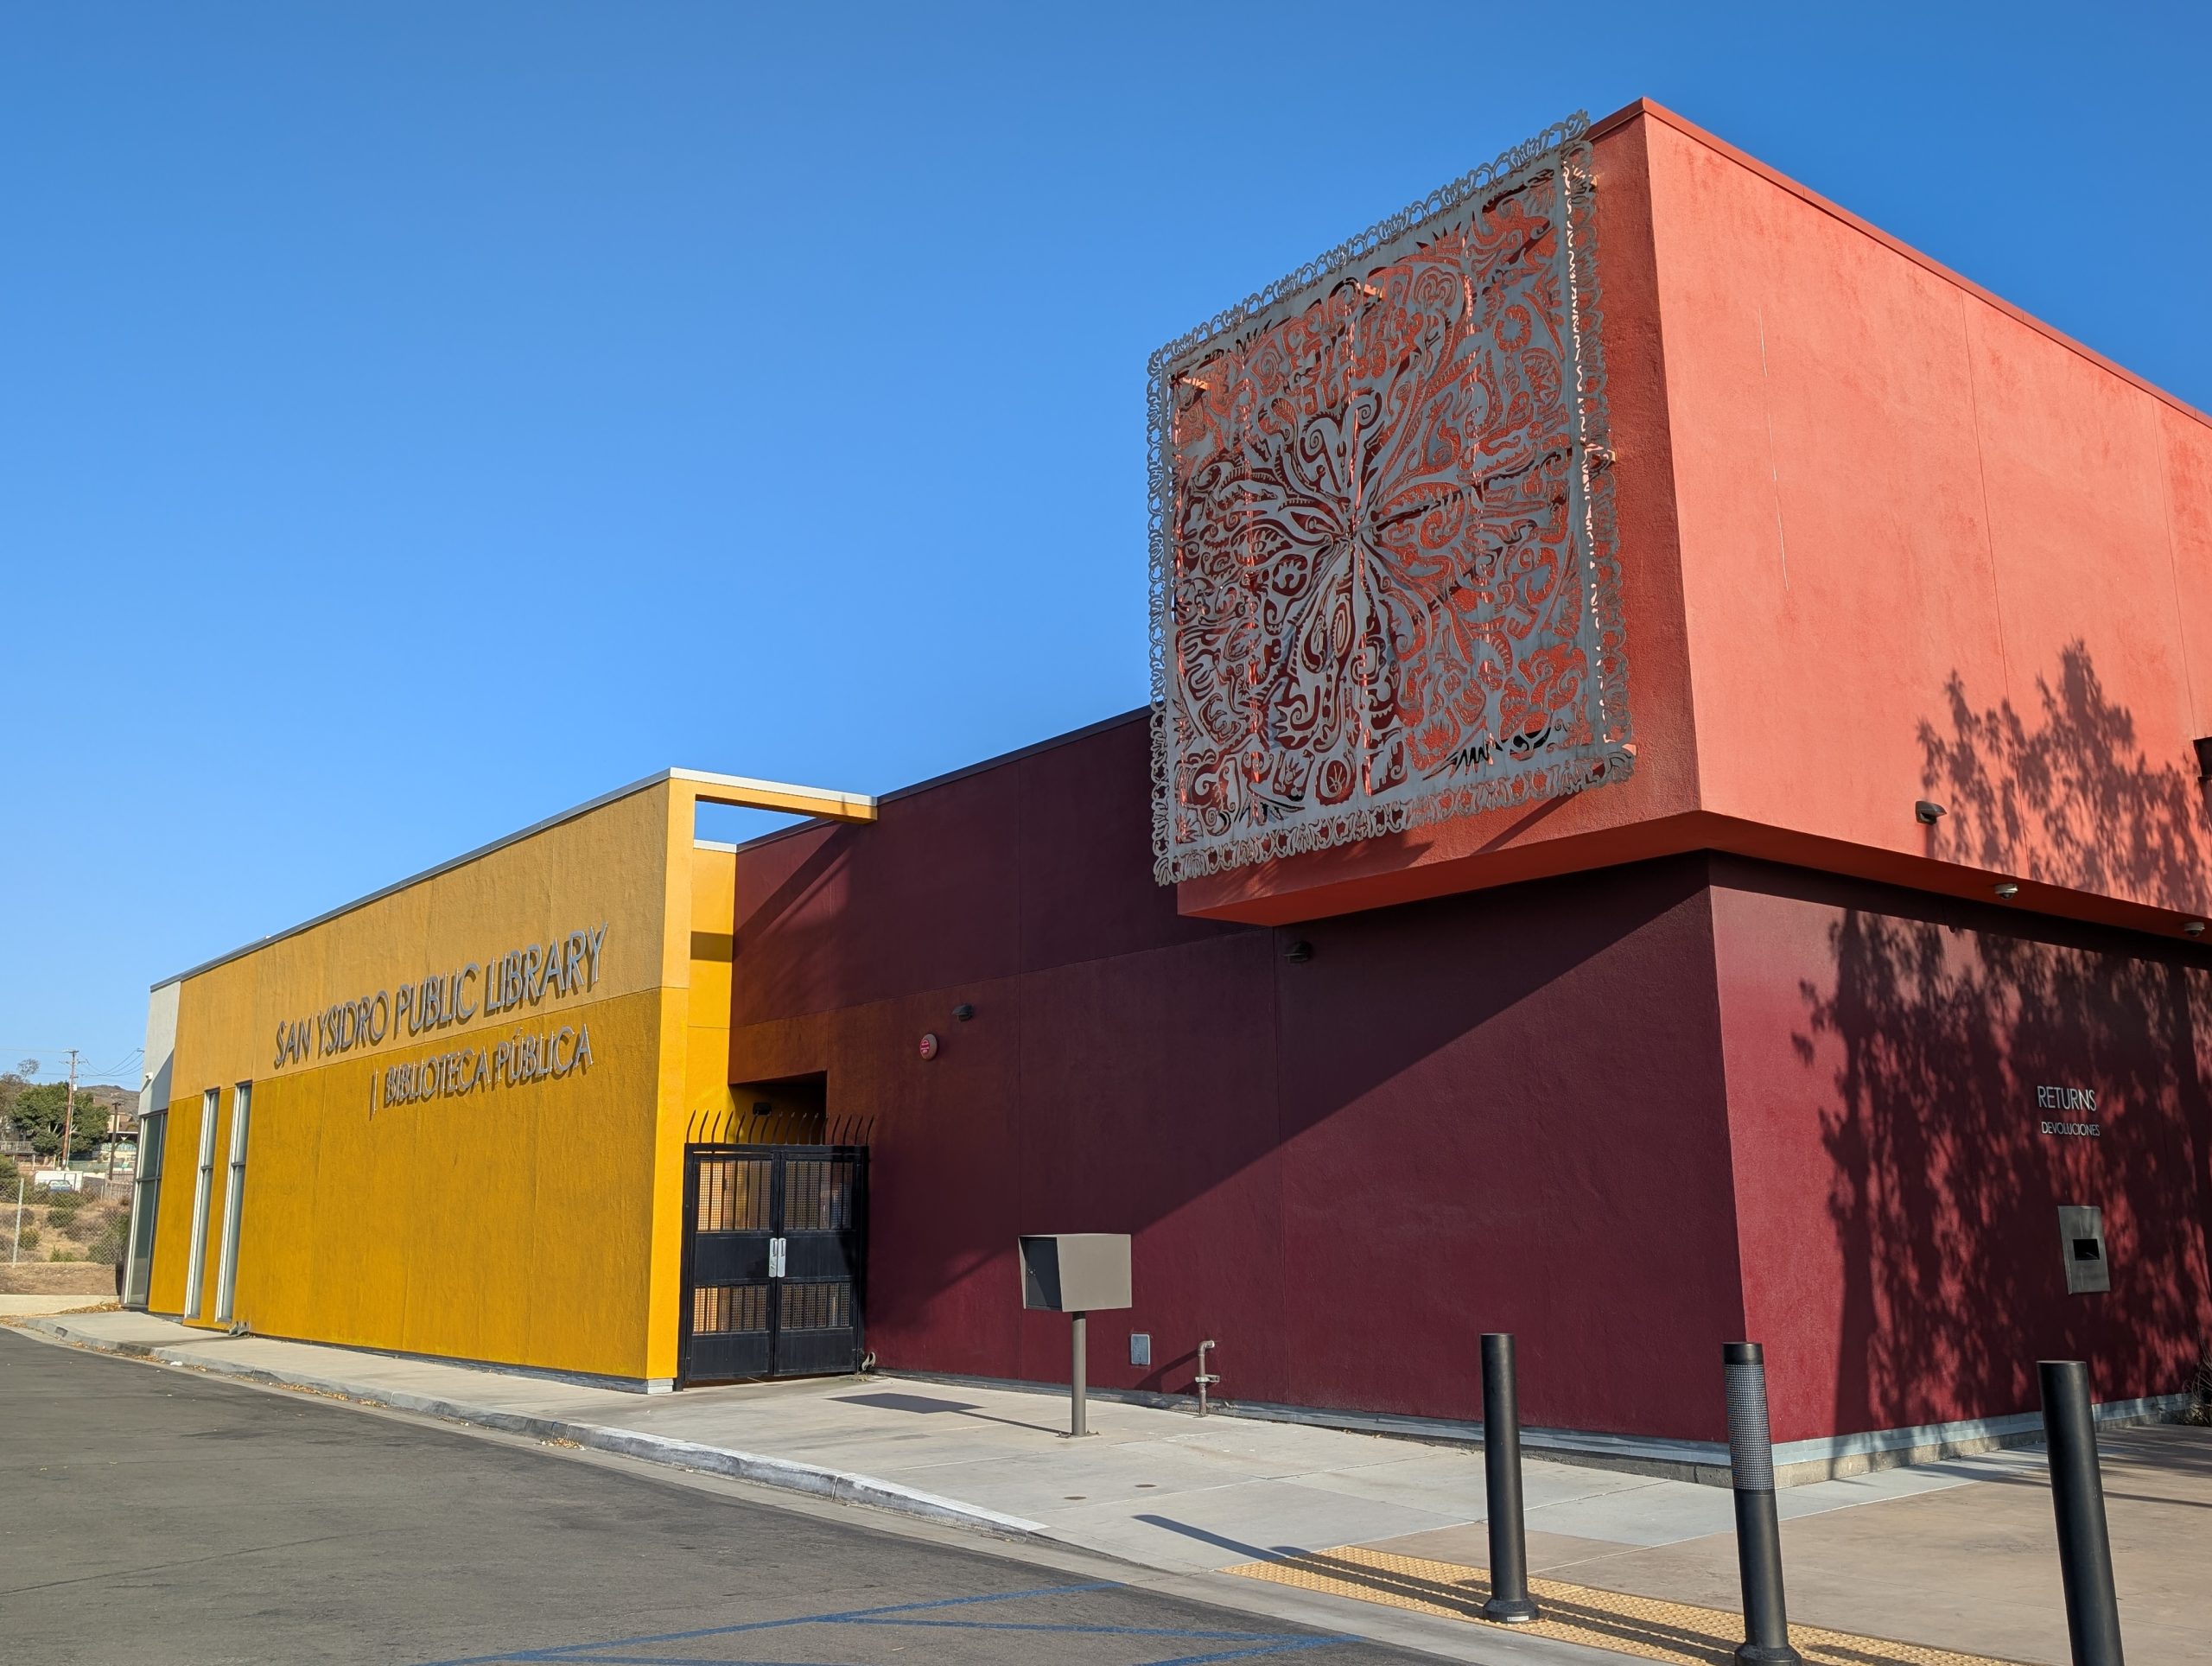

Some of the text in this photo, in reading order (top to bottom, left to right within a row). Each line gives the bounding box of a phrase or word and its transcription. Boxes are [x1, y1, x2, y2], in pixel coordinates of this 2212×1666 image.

[275, 921, 608, 1066] SAN YSIDRO PUBLIC LIBRARY
[386, 1046, 491, 1104] BIBLIOTECA
[497, 1023, 594, 1084] PÚBLICA
[2037, 1085, 2097, 1112] RETURNS
[2041, 1121, 2101, 1136] DEVOLUCIONES
